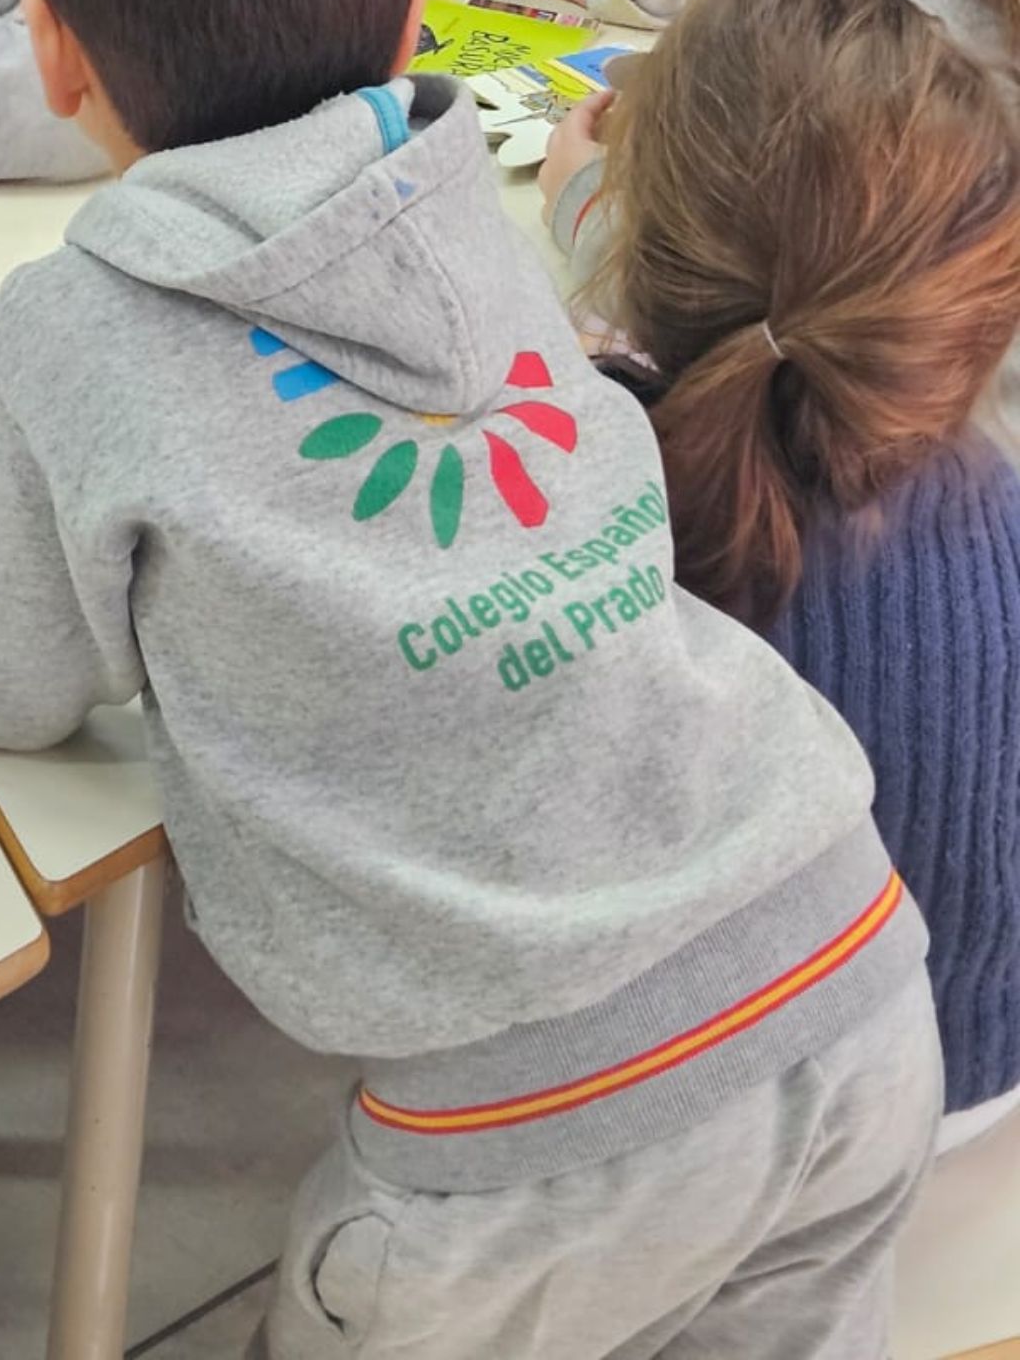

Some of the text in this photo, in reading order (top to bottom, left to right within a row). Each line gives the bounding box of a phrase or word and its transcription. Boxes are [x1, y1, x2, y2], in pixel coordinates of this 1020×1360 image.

[397, 481, 667, 671] Colegio Español
[497, 565, 667, 692] del Prado
